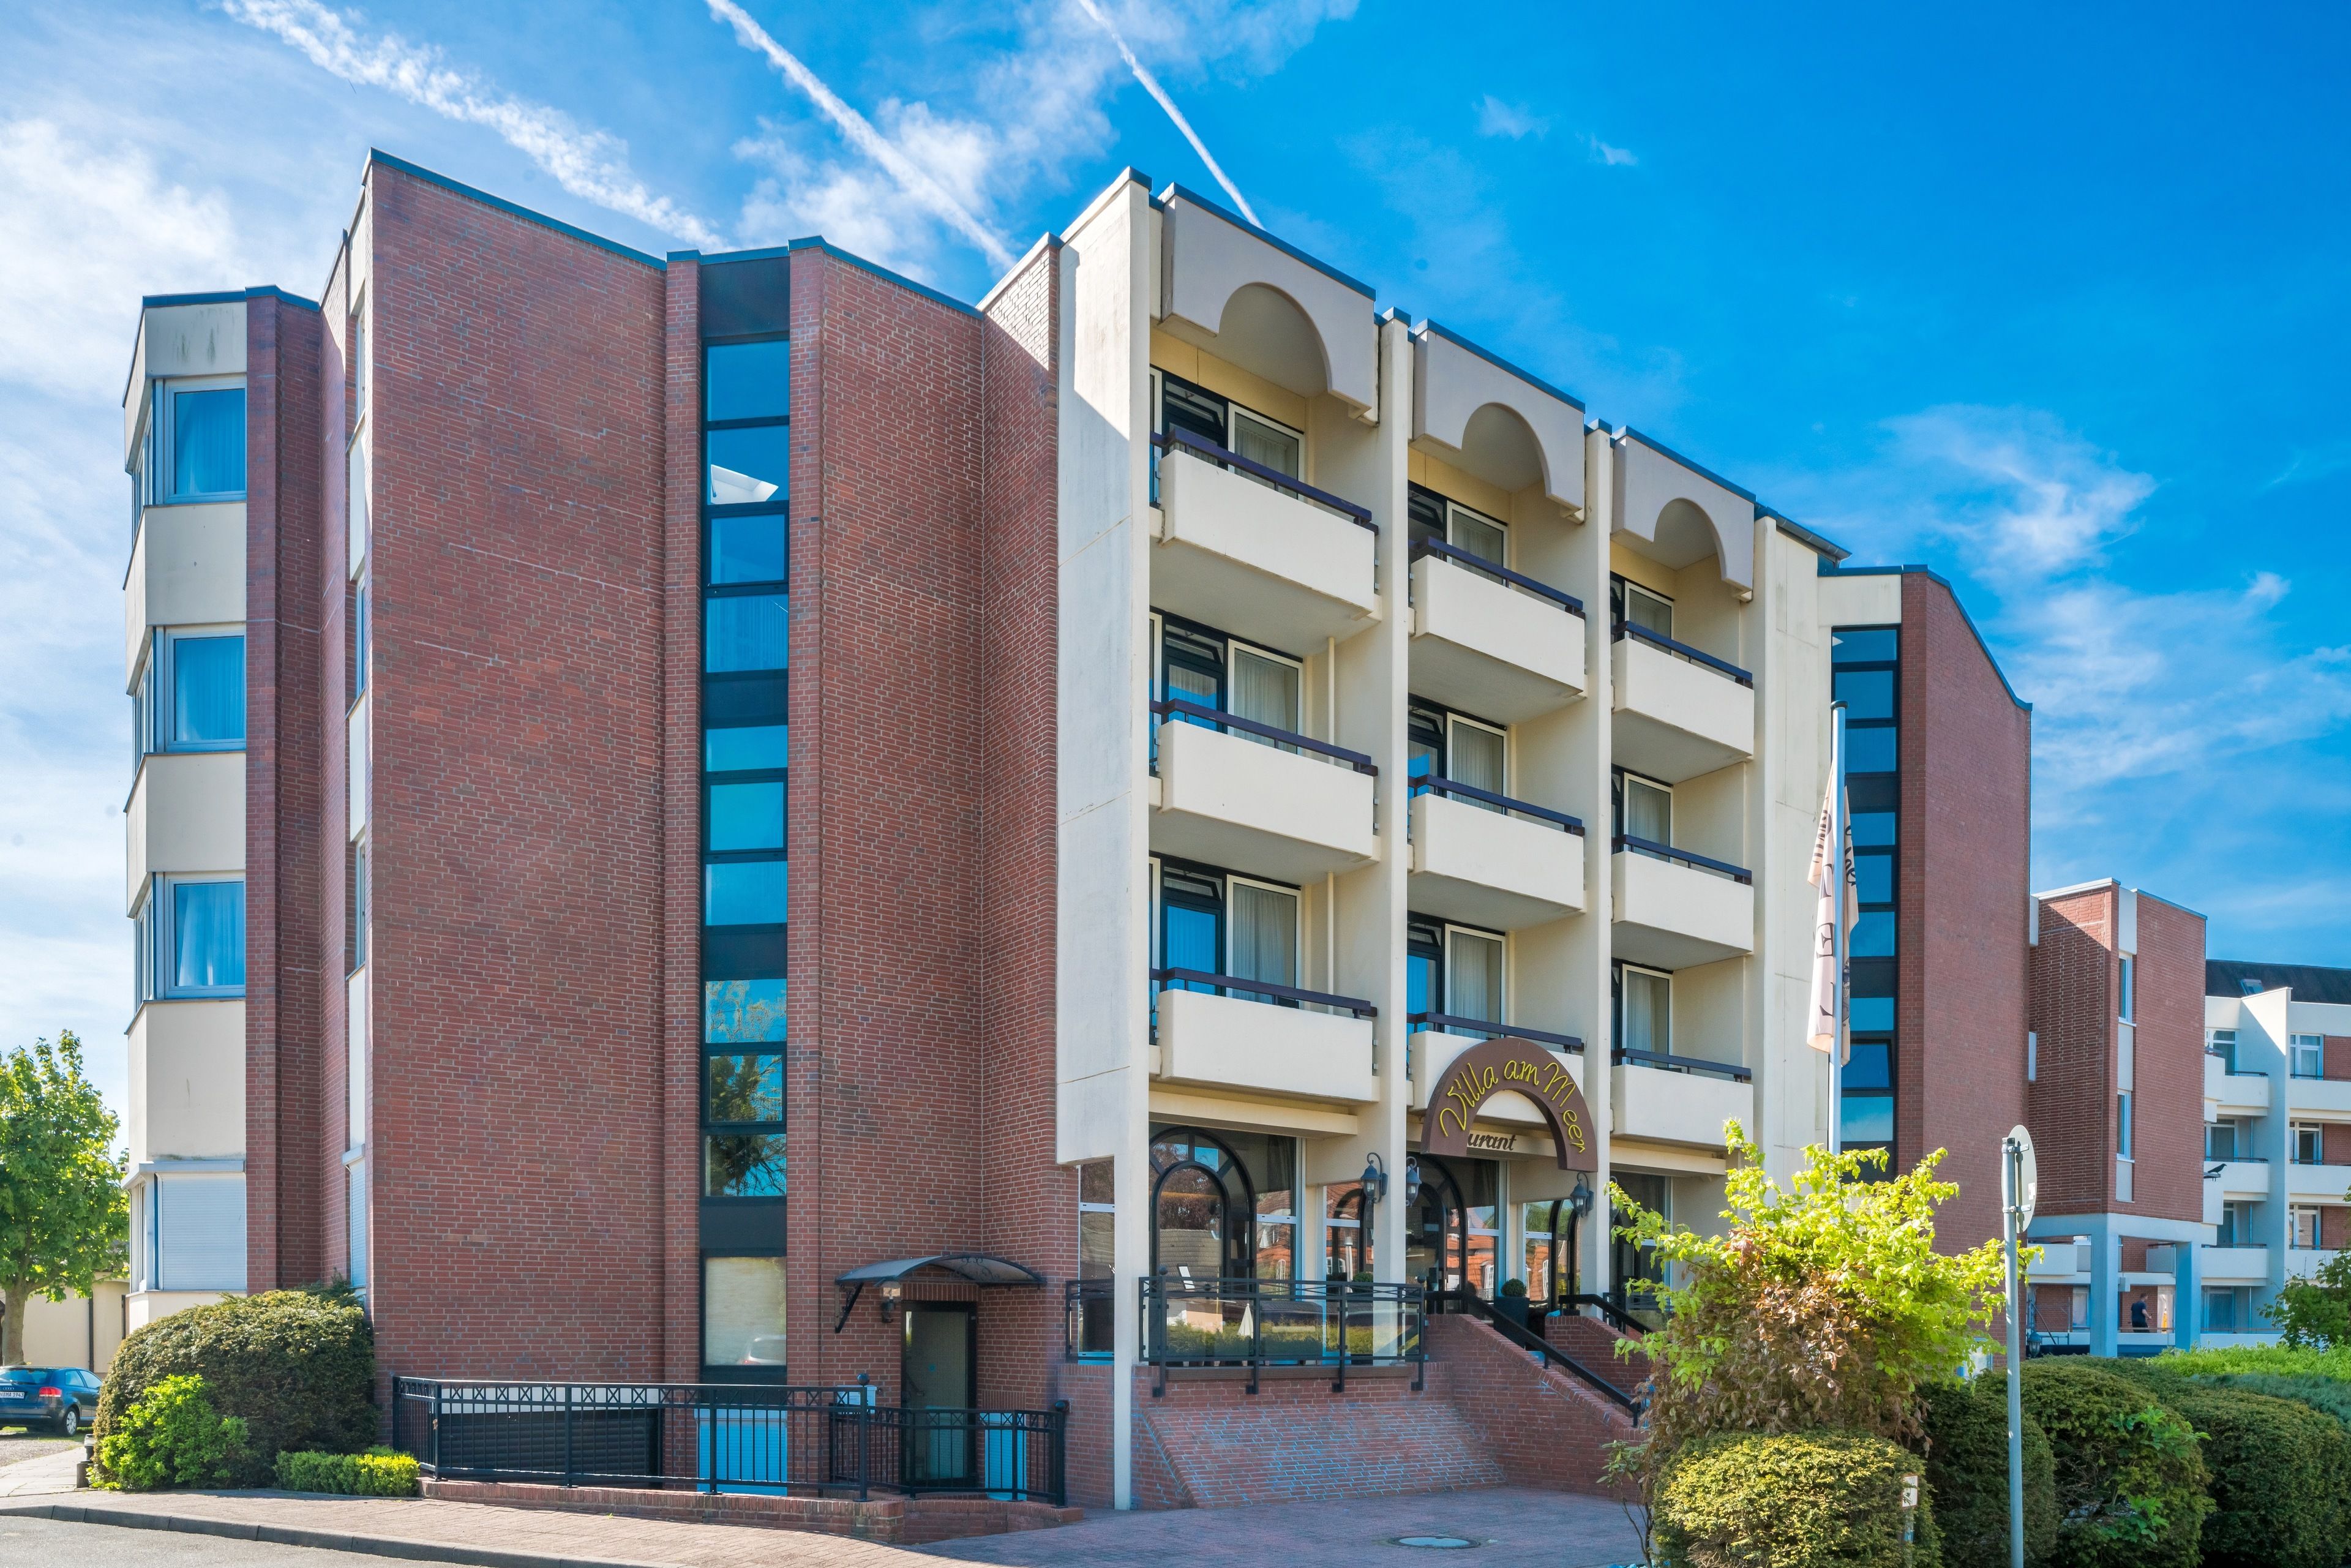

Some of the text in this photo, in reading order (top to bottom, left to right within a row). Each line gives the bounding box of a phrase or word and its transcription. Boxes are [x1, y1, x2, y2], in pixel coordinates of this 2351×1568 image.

[1439, 1060, 1586, 1153] Villa am Meer
[1468, 1133, 1517, 1151] urant
